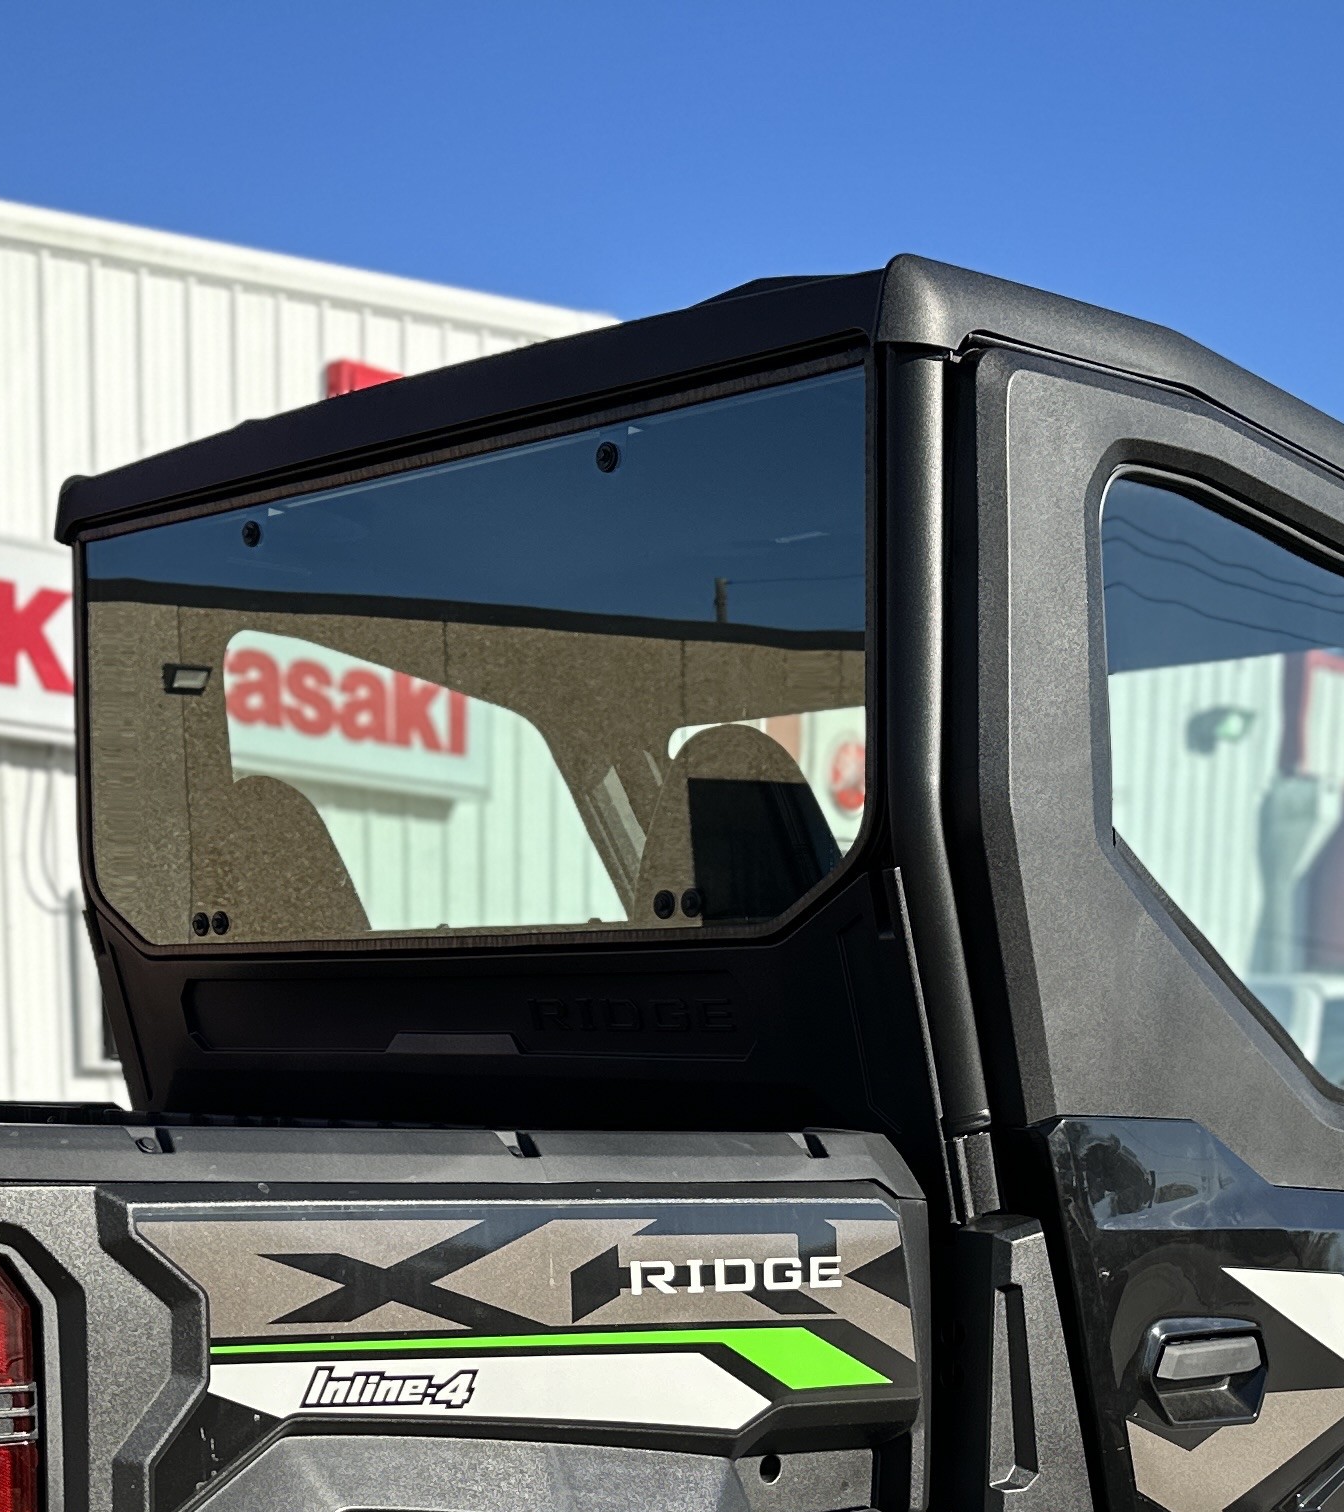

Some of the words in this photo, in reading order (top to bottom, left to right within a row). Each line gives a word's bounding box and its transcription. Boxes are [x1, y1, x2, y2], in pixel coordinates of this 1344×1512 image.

[527, 997, 737, 1032] RIDGE
[630, 1256, 843, 1296] RIDGE
[300, 1366, 479, 1409] Inline-4
